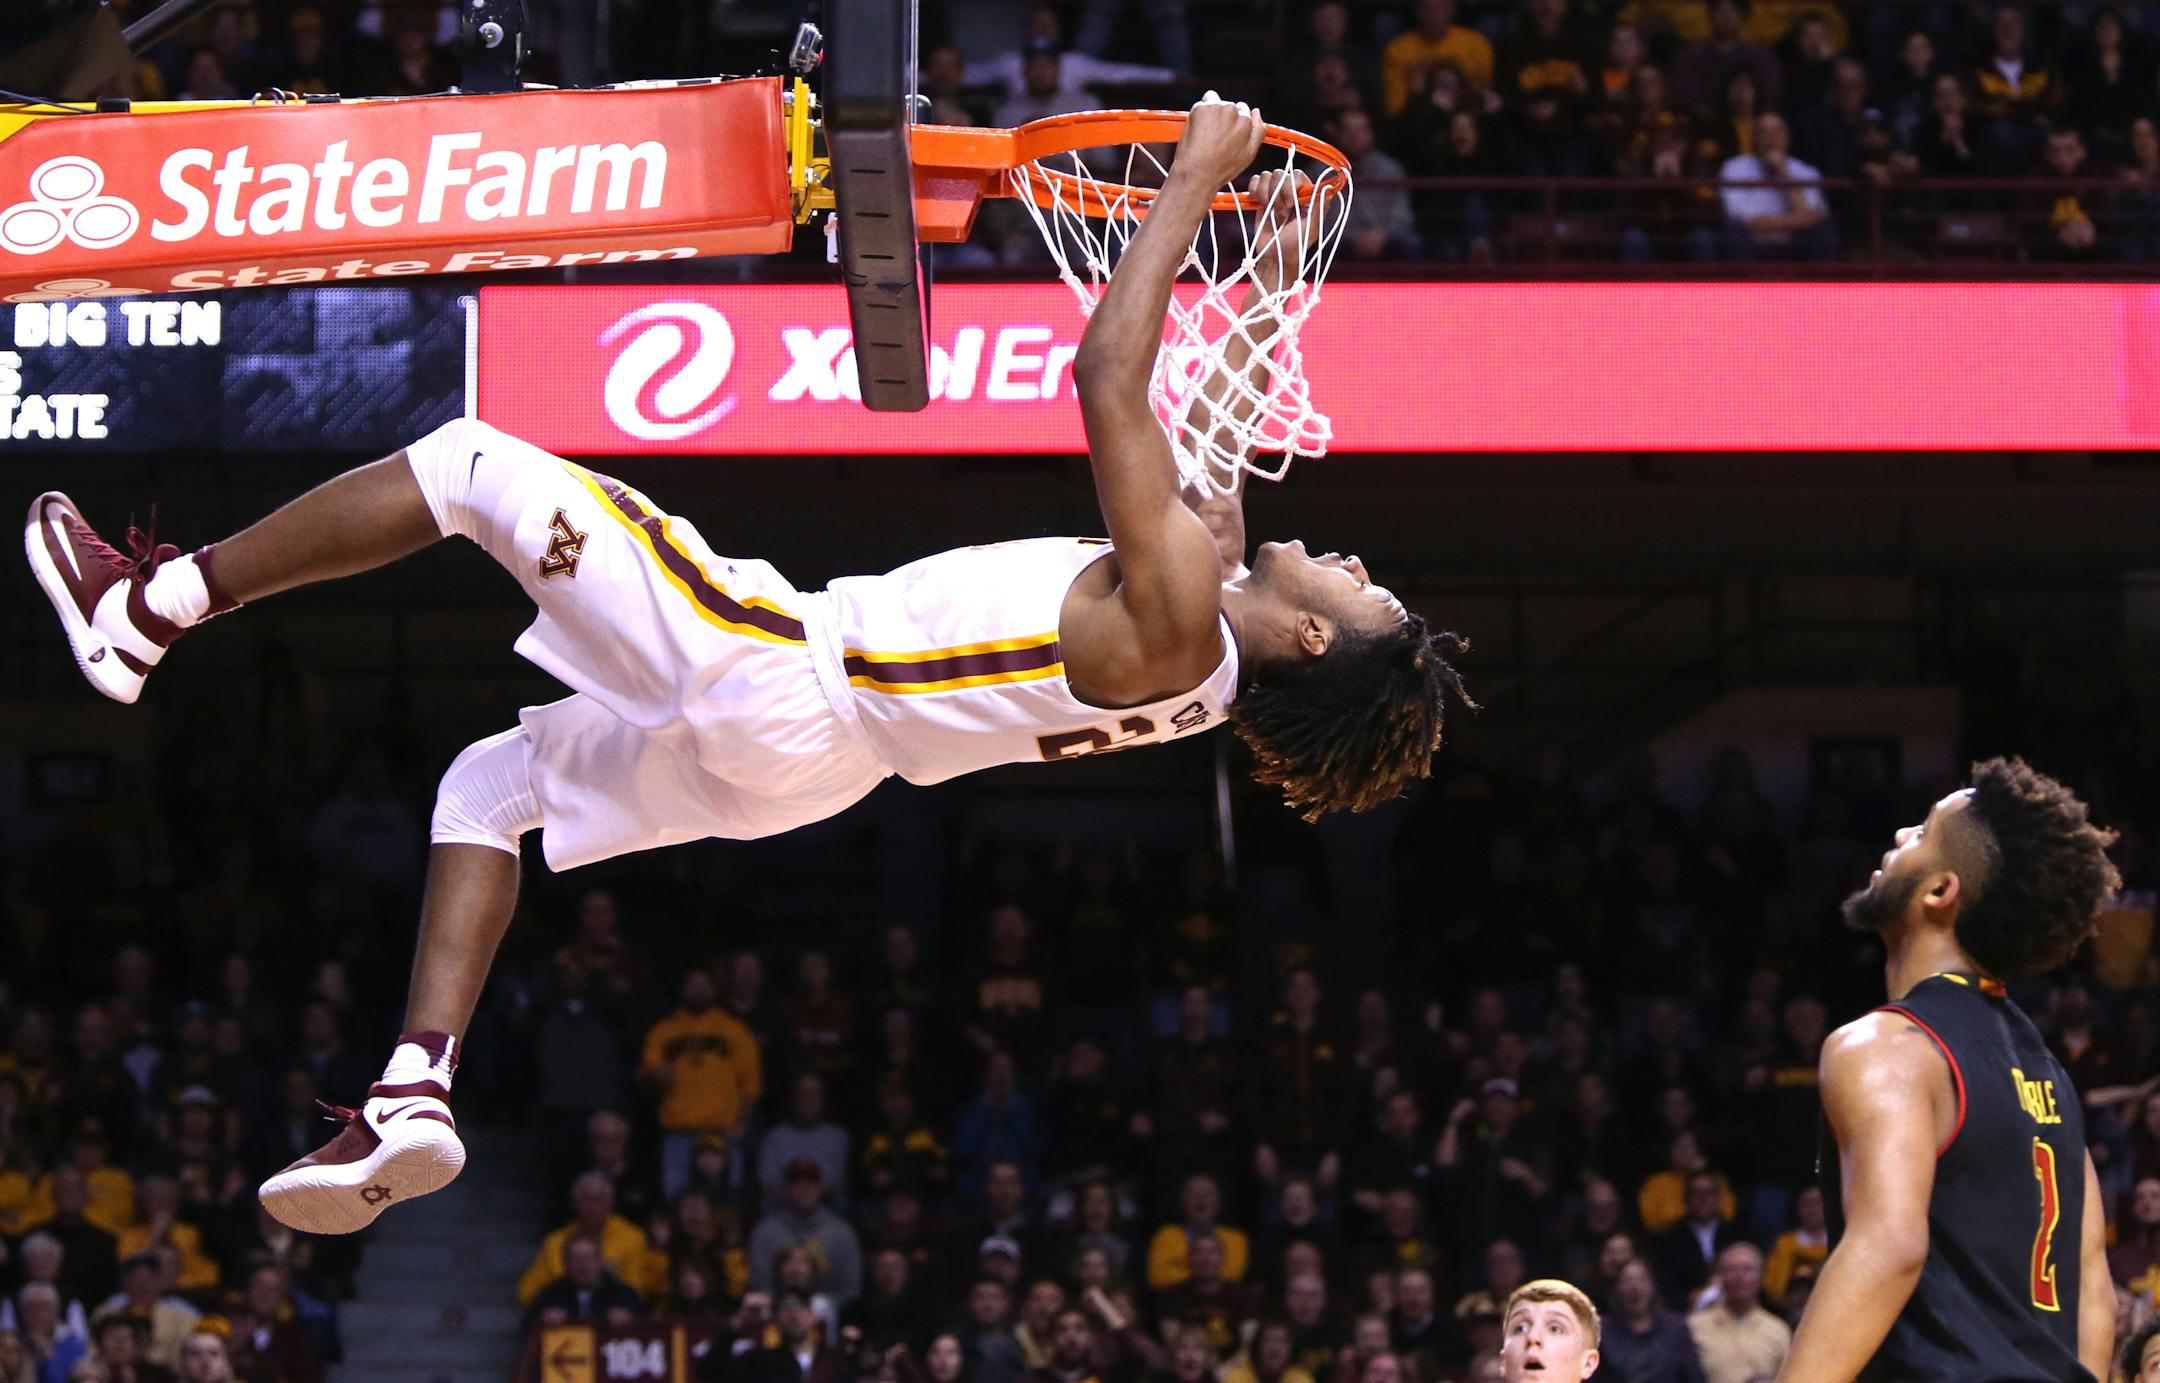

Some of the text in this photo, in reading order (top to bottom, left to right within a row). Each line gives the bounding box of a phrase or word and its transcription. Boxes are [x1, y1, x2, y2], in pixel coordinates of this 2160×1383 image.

[14, 301, 221, 347] BIG TEN
[2031, 1136, 2060, 1311] 2
[602, 1338, 666, 1379] 104
